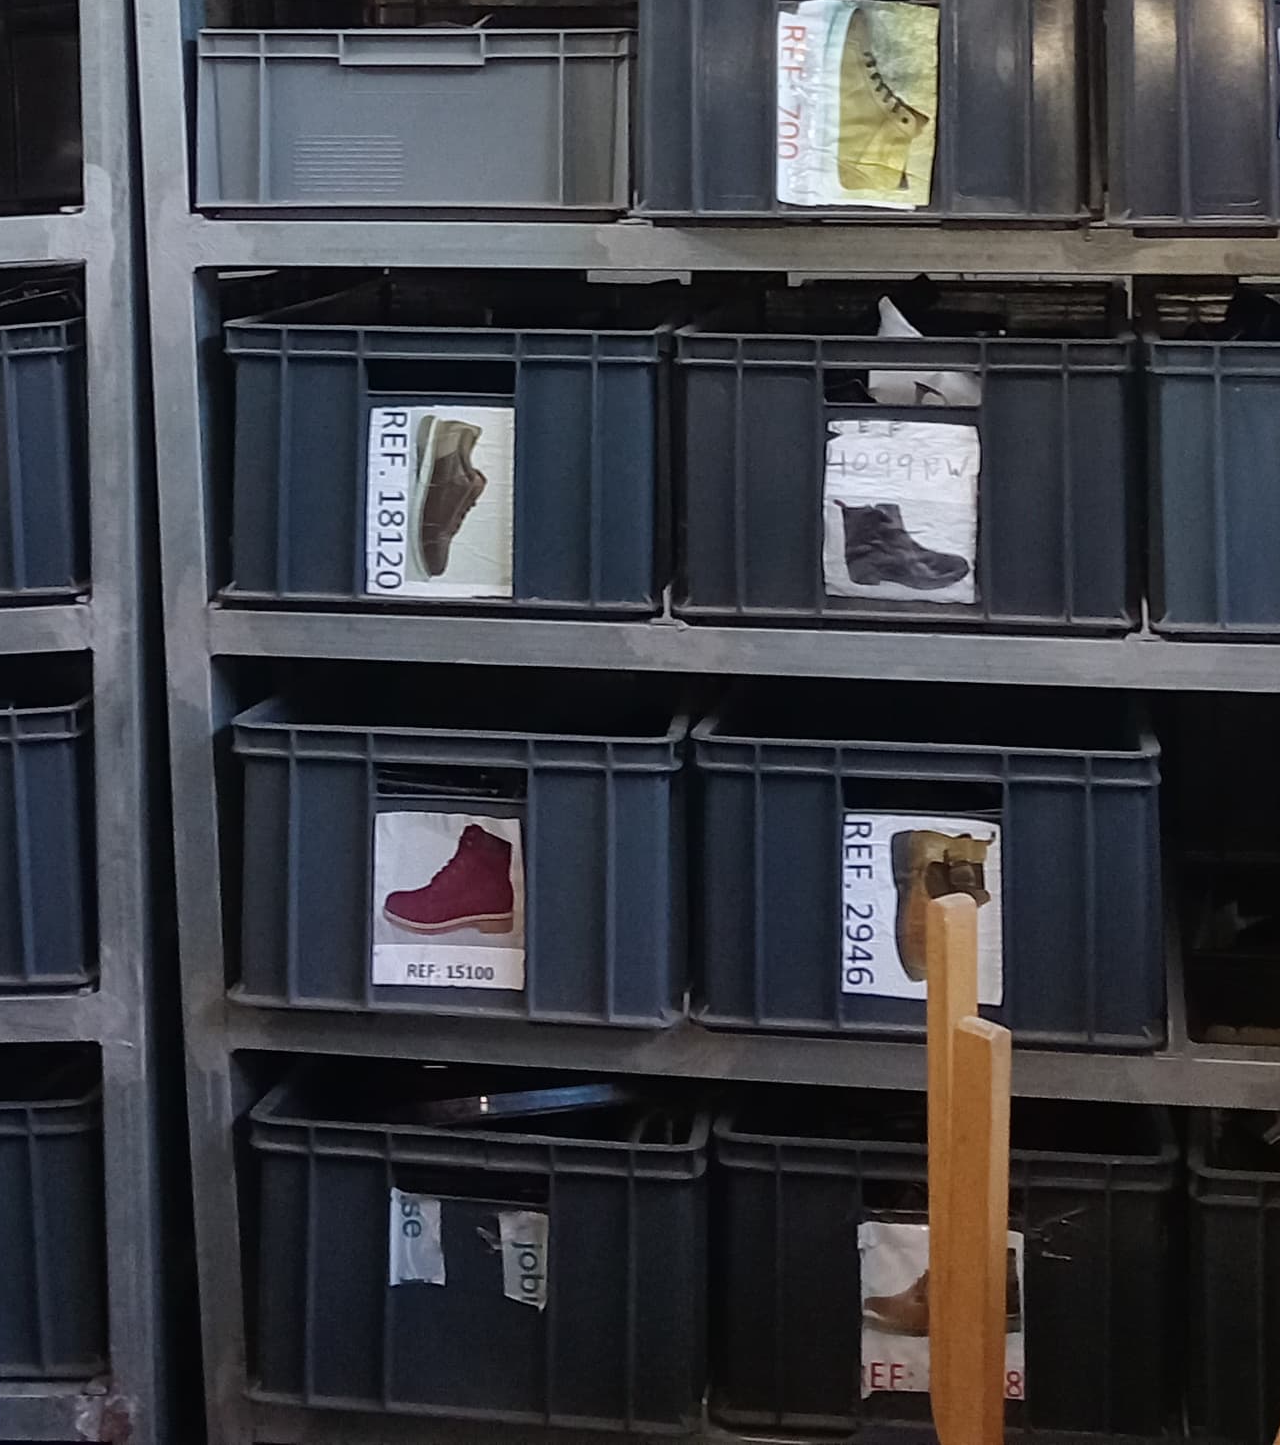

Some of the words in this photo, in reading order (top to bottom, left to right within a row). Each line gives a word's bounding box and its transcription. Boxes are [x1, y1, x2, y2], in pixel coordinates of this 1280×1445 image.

[777, 105, 802, 160] 700
[378, 411, 408, 477] REF.
[374, 490, 406, 590] 18120
[843, 821, 873, 889] REF.
[406, 963, 442, 978] REF:
[446, 964, 495, 981] 15100
[844, 903, 875, 986] 2946
